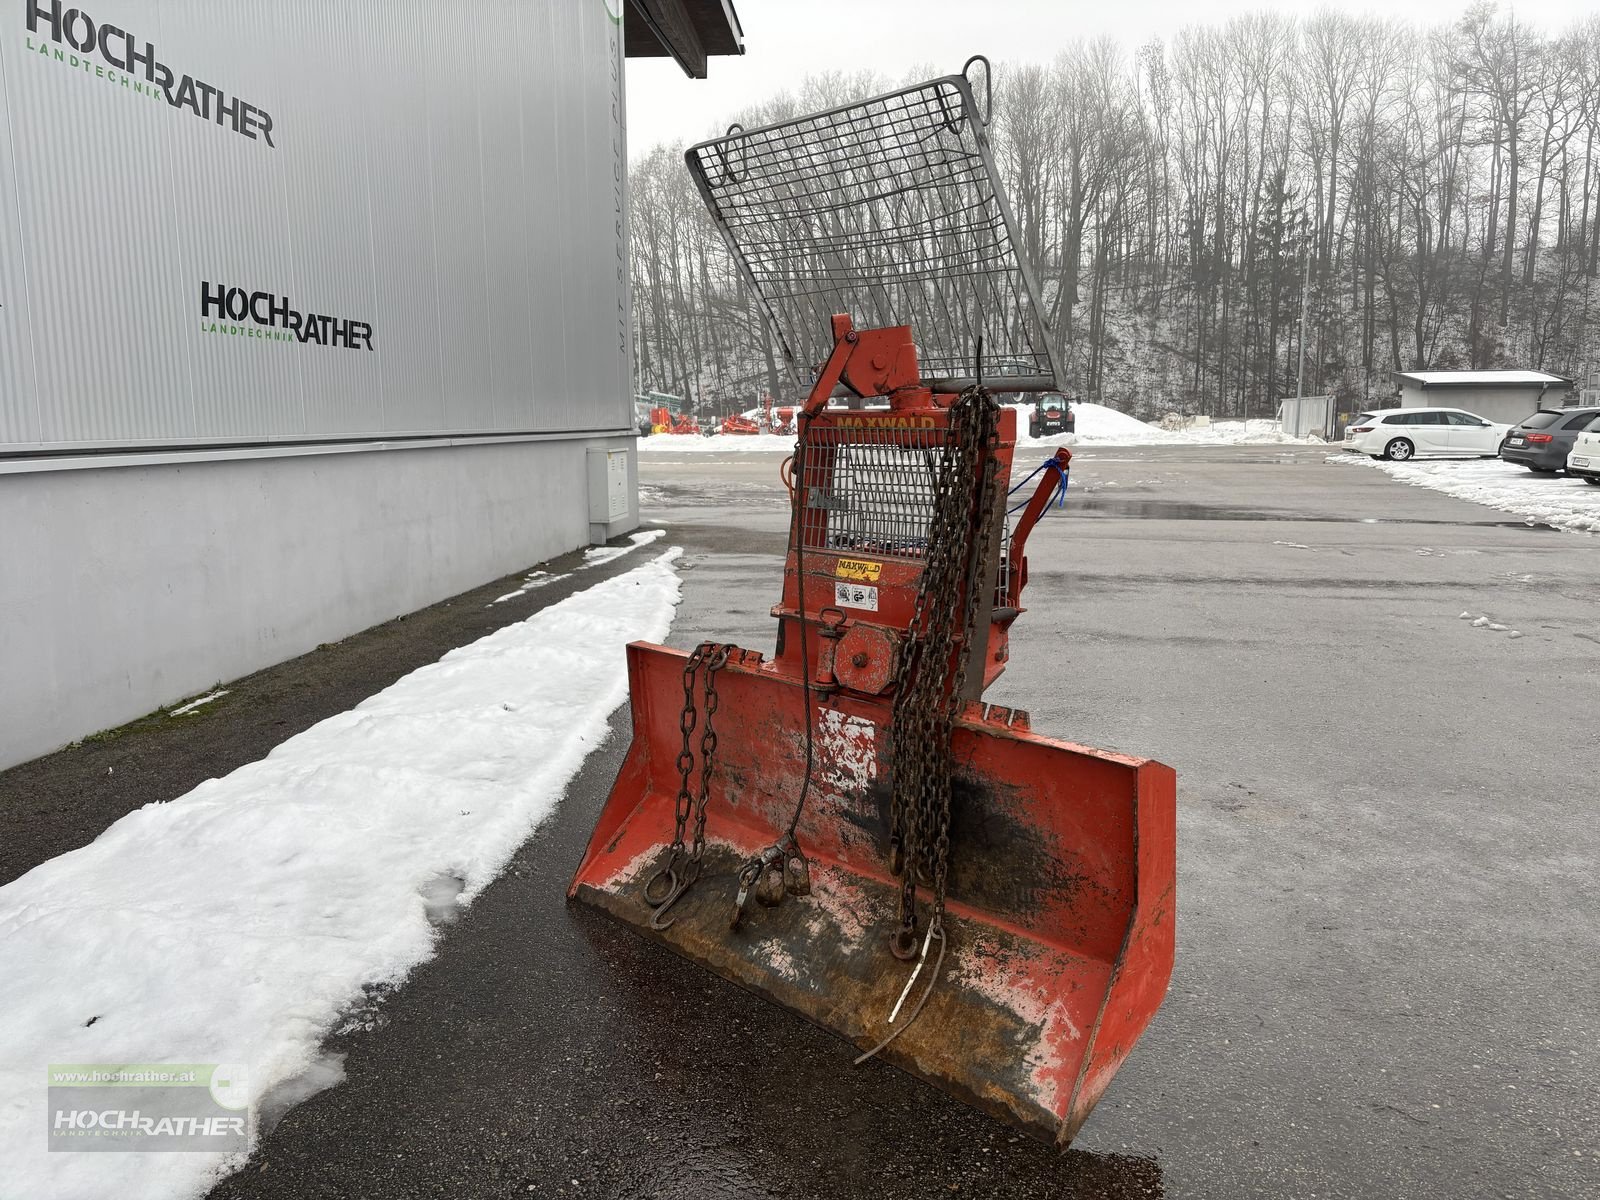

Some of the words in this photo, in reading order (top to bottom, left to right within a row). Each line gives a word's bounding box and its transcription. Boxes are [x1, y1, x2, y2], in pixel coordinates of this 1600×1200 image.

[26, 36, 162, 101] LANDTECHNIK
[26, 0, 275, 148] HOCHRATHER
[201, 280, 374, 351] HOCHRATHER
[201, 321, 294, 343] LANDTECHNIK
